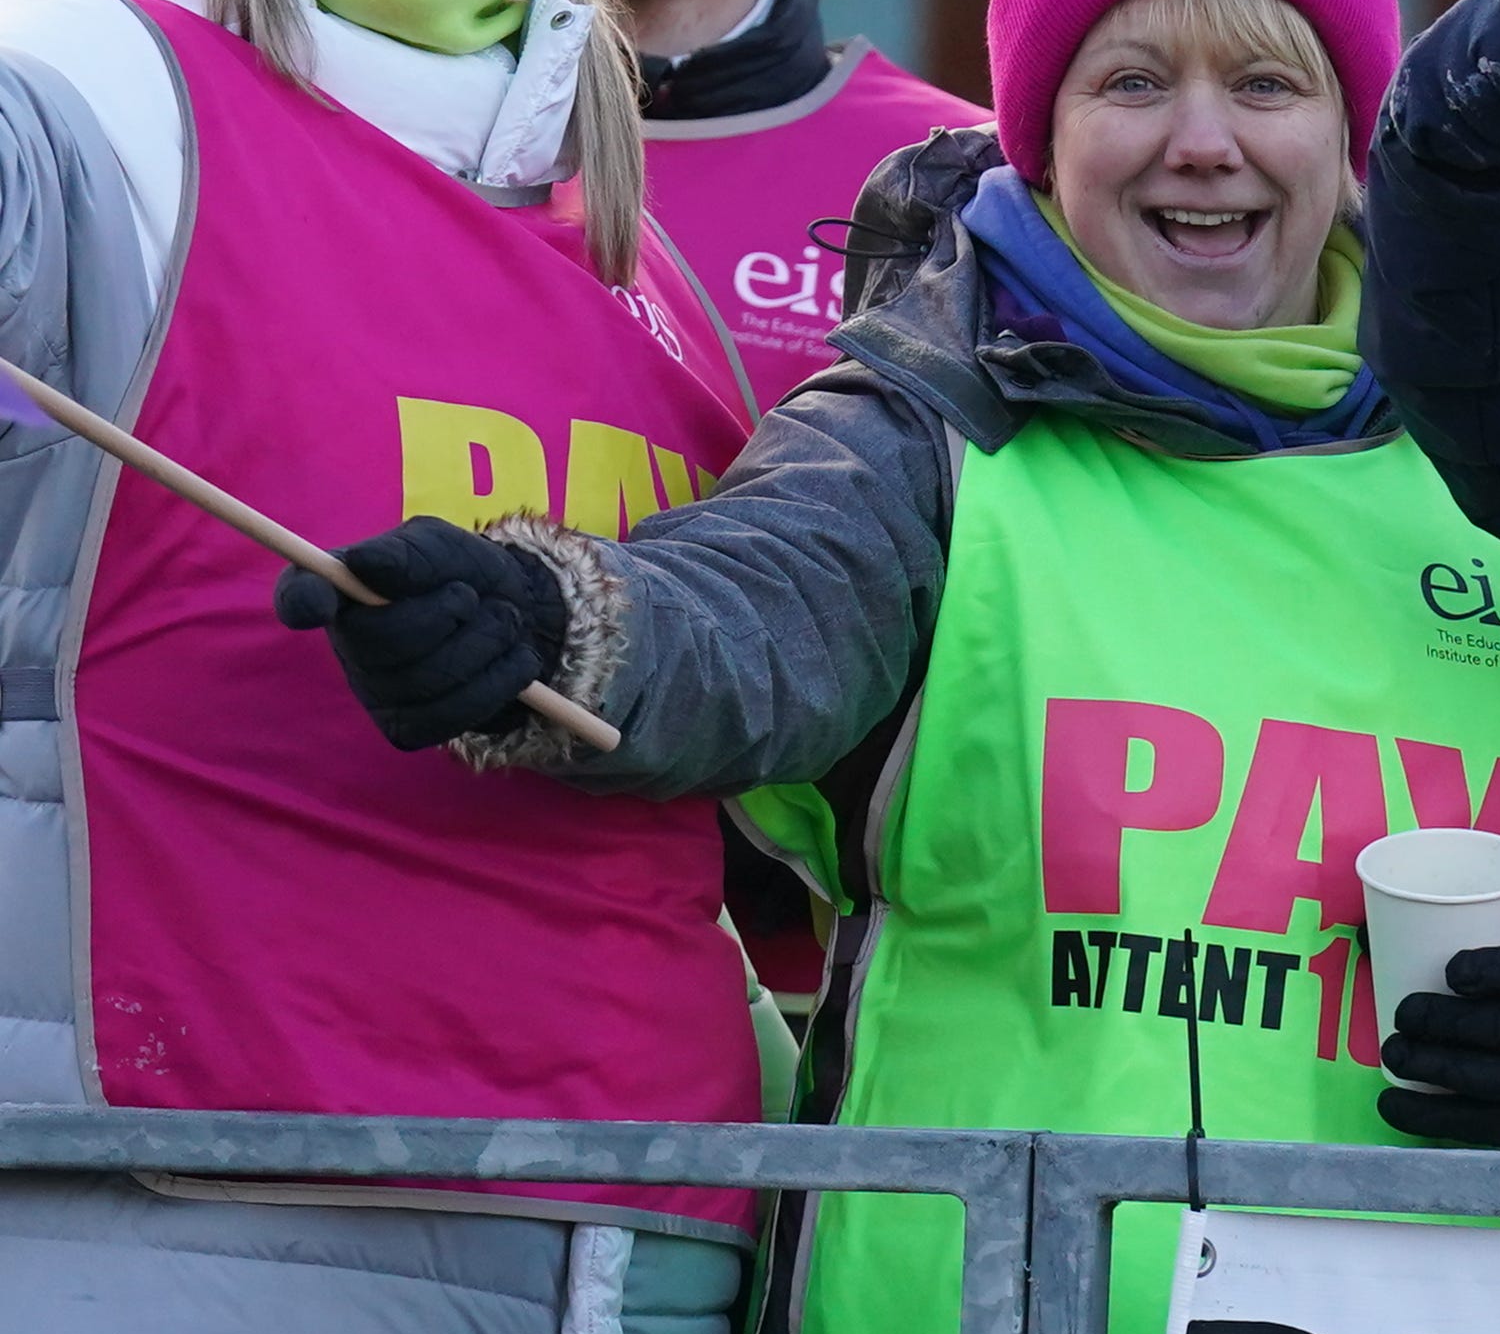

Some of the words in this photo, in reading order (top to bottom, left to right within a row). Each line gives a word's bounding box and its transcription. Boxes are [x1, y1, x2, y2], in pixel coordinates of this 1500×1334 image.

[1436, 628, 1463, 645] The
[1426, 644, 1481, 665] Institute
[1485, 655, 1500, 667] of
[1051, 929, 1382, 1068] ATTENT1
